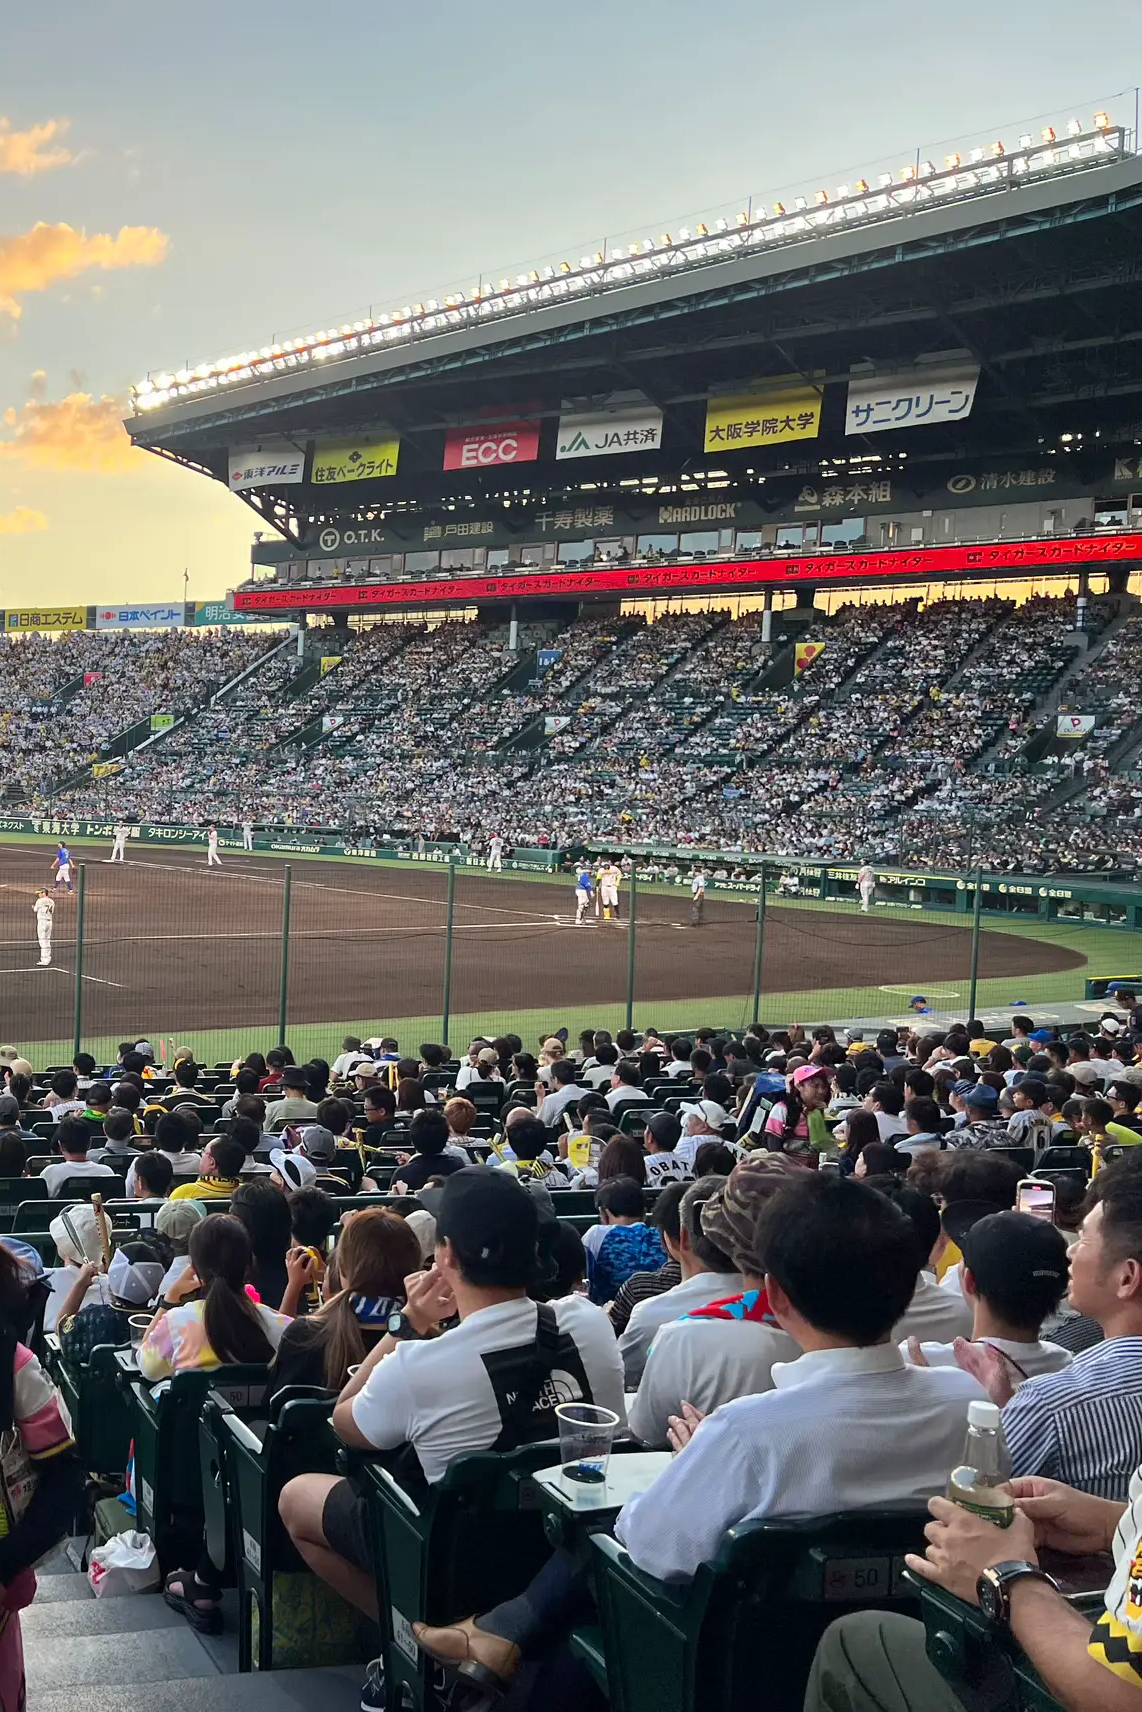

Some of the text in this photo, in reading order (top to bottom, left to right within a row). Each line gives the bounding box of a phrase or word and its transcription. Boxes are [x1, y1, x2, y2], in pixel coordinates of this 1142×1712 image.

[851, 389, 970, 427] サニクリーン
[709, 411, 815, 443] 大阪学院大学
[594, 428, 658, 449] JA共済
[461, 438, 518, 466] ECC
[243, 463, 300, 480] 東洋アルミ
[315, 458, 394, 482] 住友ベークライト
[981, 468, 1057, 490] 清水建設
[821, 481, 892, 507] 森本組
[535, 505, 614, 531] 千寿製薬
[344, 527, 385, 545] O.T.K.
[444, 521, 494, 537] 戸田建設
[989, 541, 1138, 561] タイガースカードナイター
[804, 555, 934, 572] タイガースカードナイター
[501, 577, 602, 591] タイガースカードナイター
[643, 567, 757, 583] タイガースカードナイター
[255, 594, 337, 605] タイガースカードナイター
[371, 585, 464, 599] タイガースカードナイター
[19, 612, 83, 627] 日商エステム
[118, 609, 181, 622] 日本ペイント
[41, 820, 80, 836] 東海大学
[1036, 1130, 1045, 1149] 6
[531, 1394, 559, 1412] ACE
[853, 1568, 878, 1587] 50
